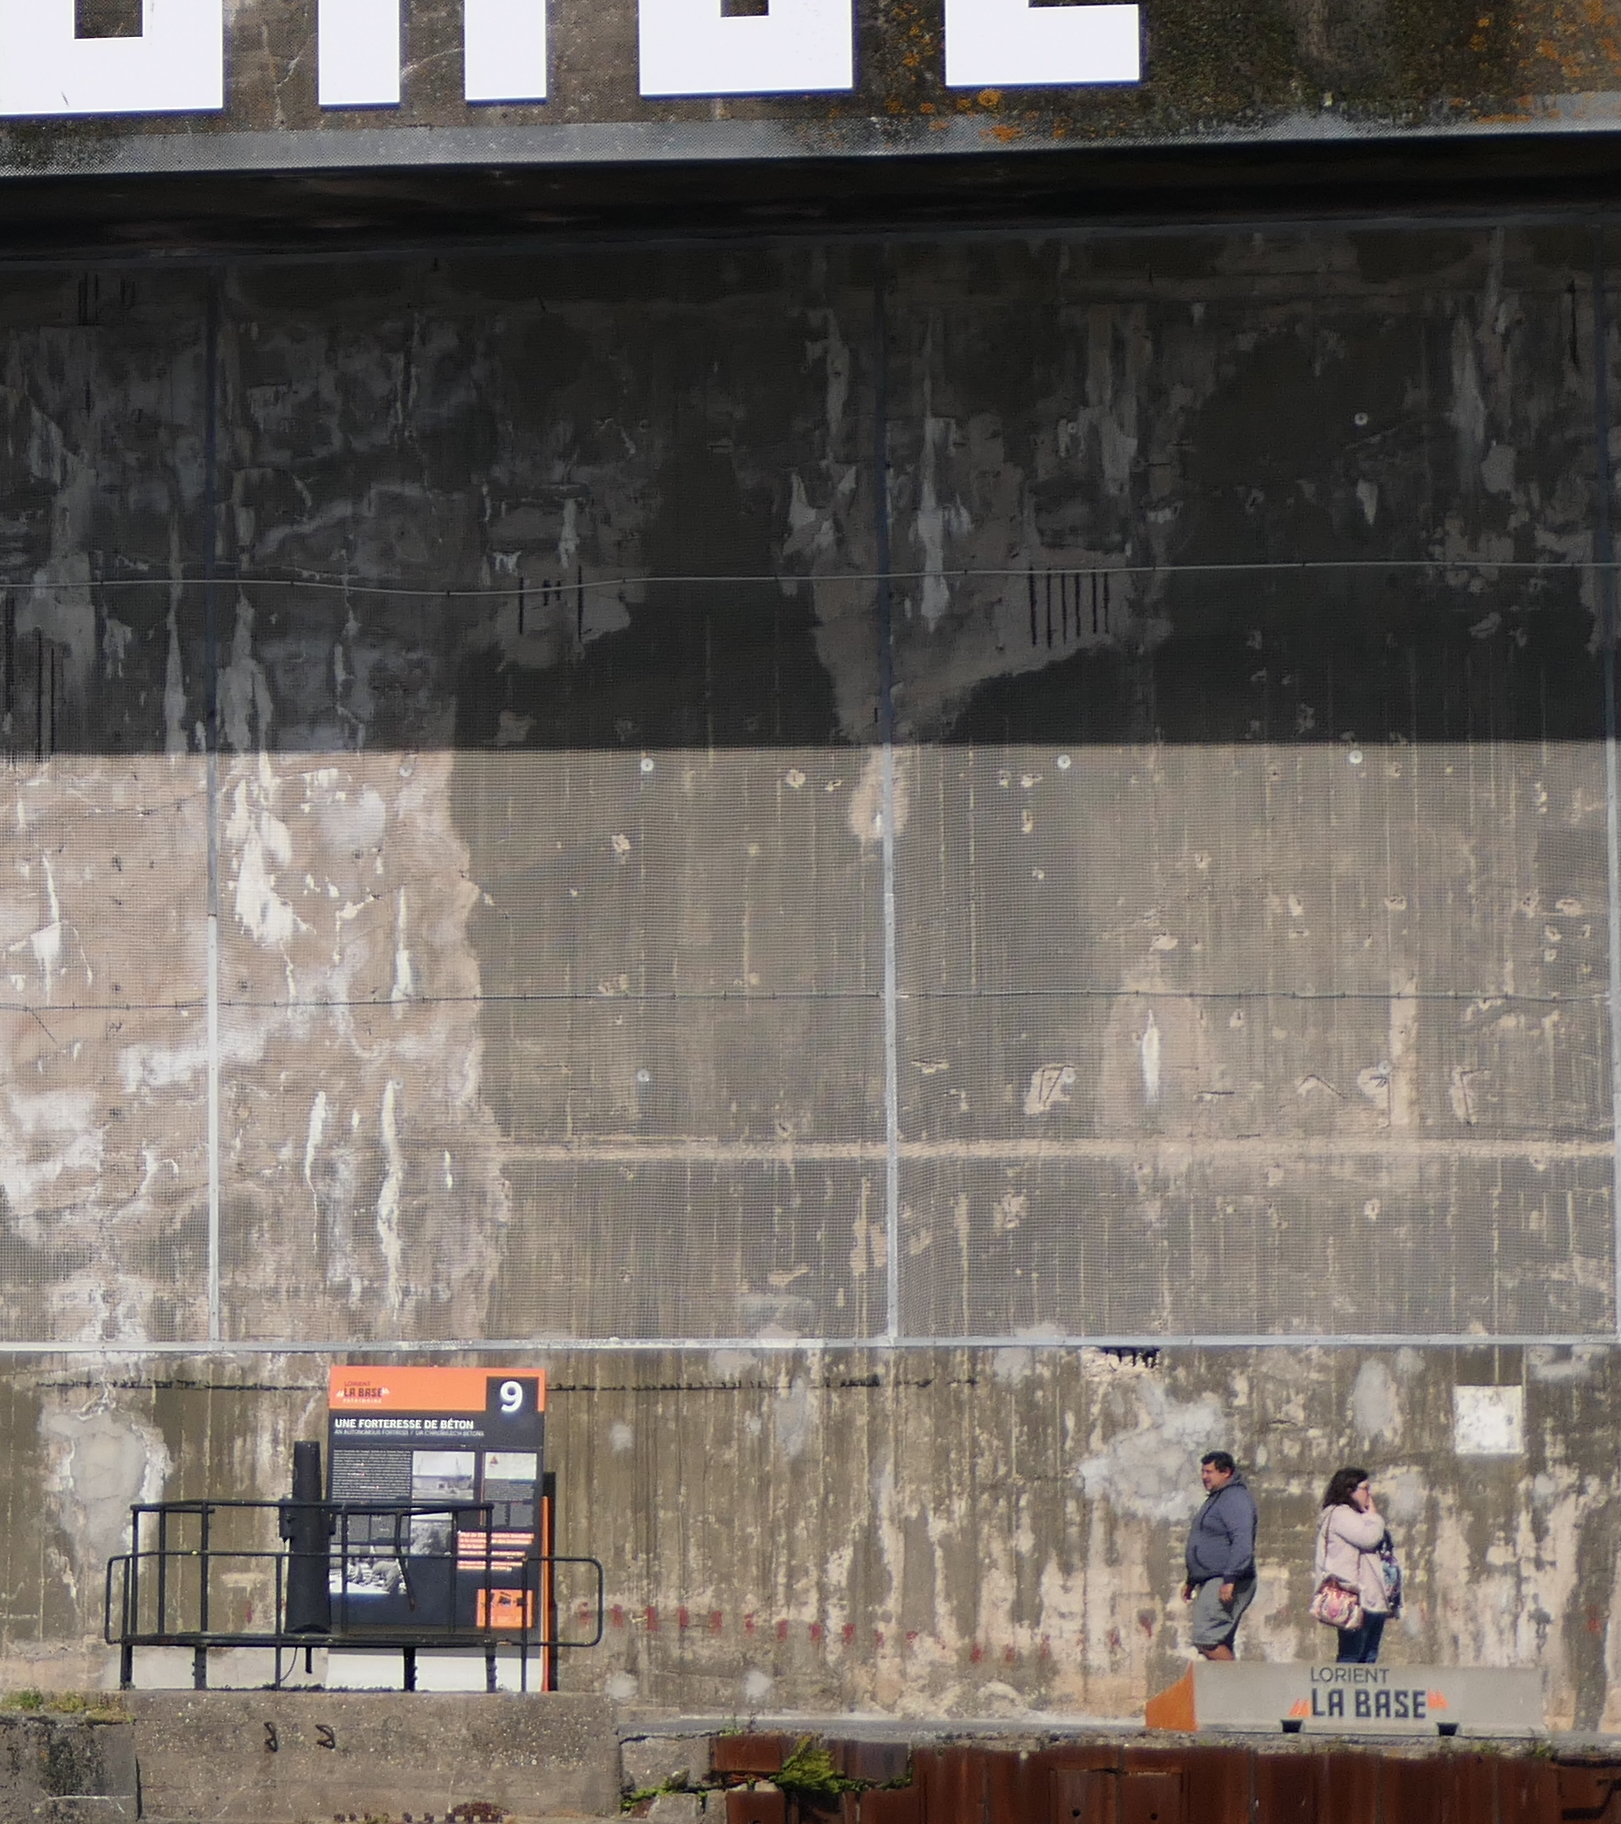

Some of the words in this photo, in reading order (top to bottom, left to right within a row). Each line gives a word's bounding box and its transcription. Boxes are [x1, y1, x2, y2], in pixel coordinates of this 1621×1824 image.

[344, 1387, 355, 1397] LA
[358, 1387, 382, 1397] BASE
[500, 1380, 523, 1412] 9
[334, 1418, 356, 1428] UNE
[358, 1418, 421, 1429] FORTERESSE
[424, 1419, 438, 1429] DE
[441, 1417, 474, 1430] BÉTON
[1310, 1666, 1390, 1684] LORIENT
[1312, 1688, 1344, 1718] LA
[1355, 1689, 1426, 1719] BASE
